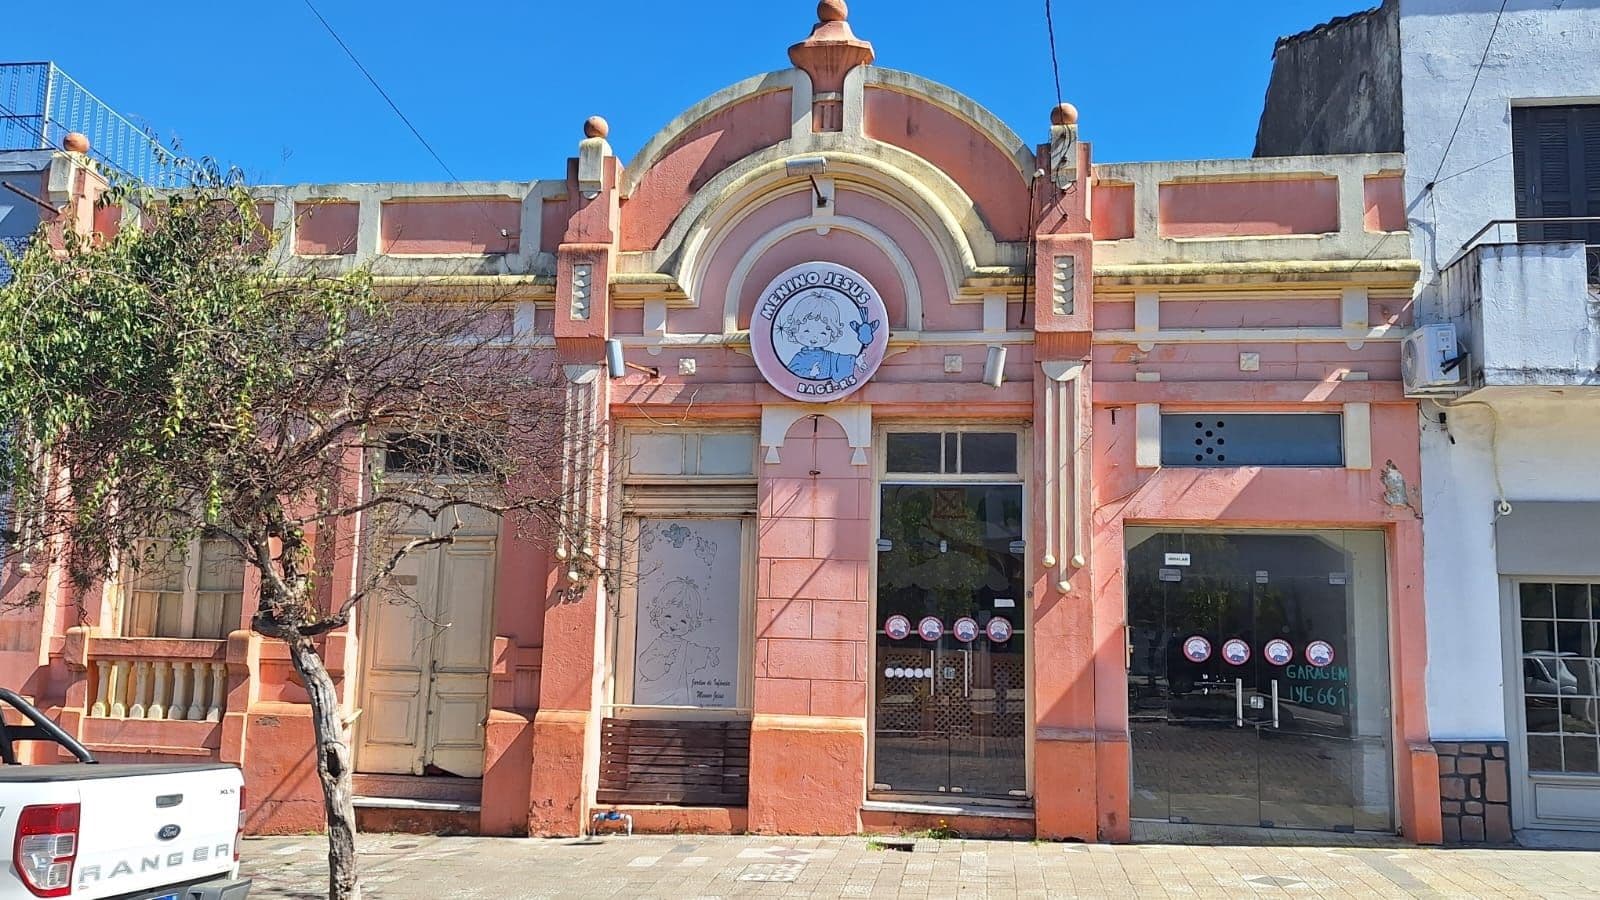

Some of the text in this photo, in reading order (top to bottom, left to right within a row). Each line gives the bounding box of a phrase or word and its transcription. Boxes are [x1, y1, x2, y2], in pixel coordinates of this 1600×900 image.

[760, 272, 870, 320] MENINO JESUS
[1286, 664, 1348, 680] GARAGEM
[161, 825, 179, 838] Ford
[79, 843, 229, 883] RANGER
